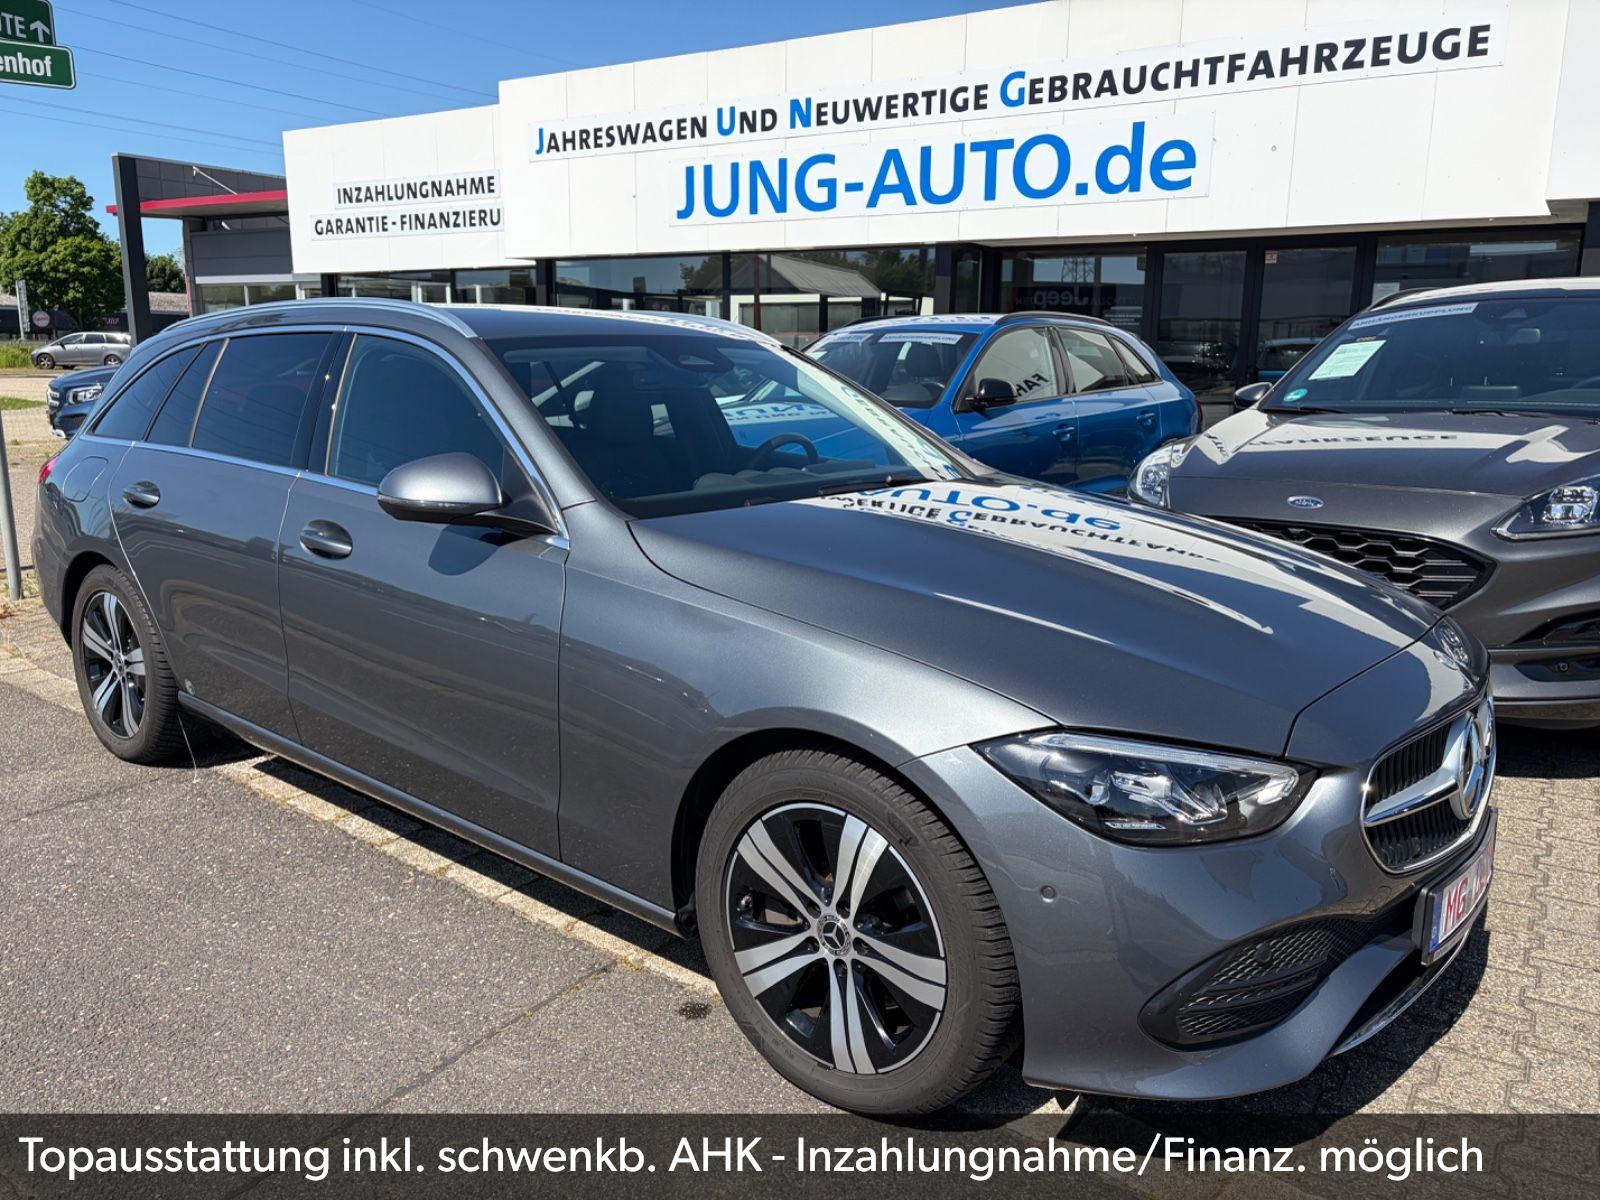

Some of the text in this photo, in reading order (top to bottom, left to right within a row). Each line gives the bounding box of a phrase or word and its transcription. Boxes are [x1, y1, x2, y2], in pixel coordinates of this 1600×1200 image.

[0, 12, 27, 38] TE
[536, 25, 1491, 155] JAHRESWAGEN UND NEUWERTIGE GEBRAUCHTFAHRZEUGE
[337, 176, 495, 204] INZAHLUNGNAHME
[676, 121, 1197, 220] JUNG-AUTO.de
